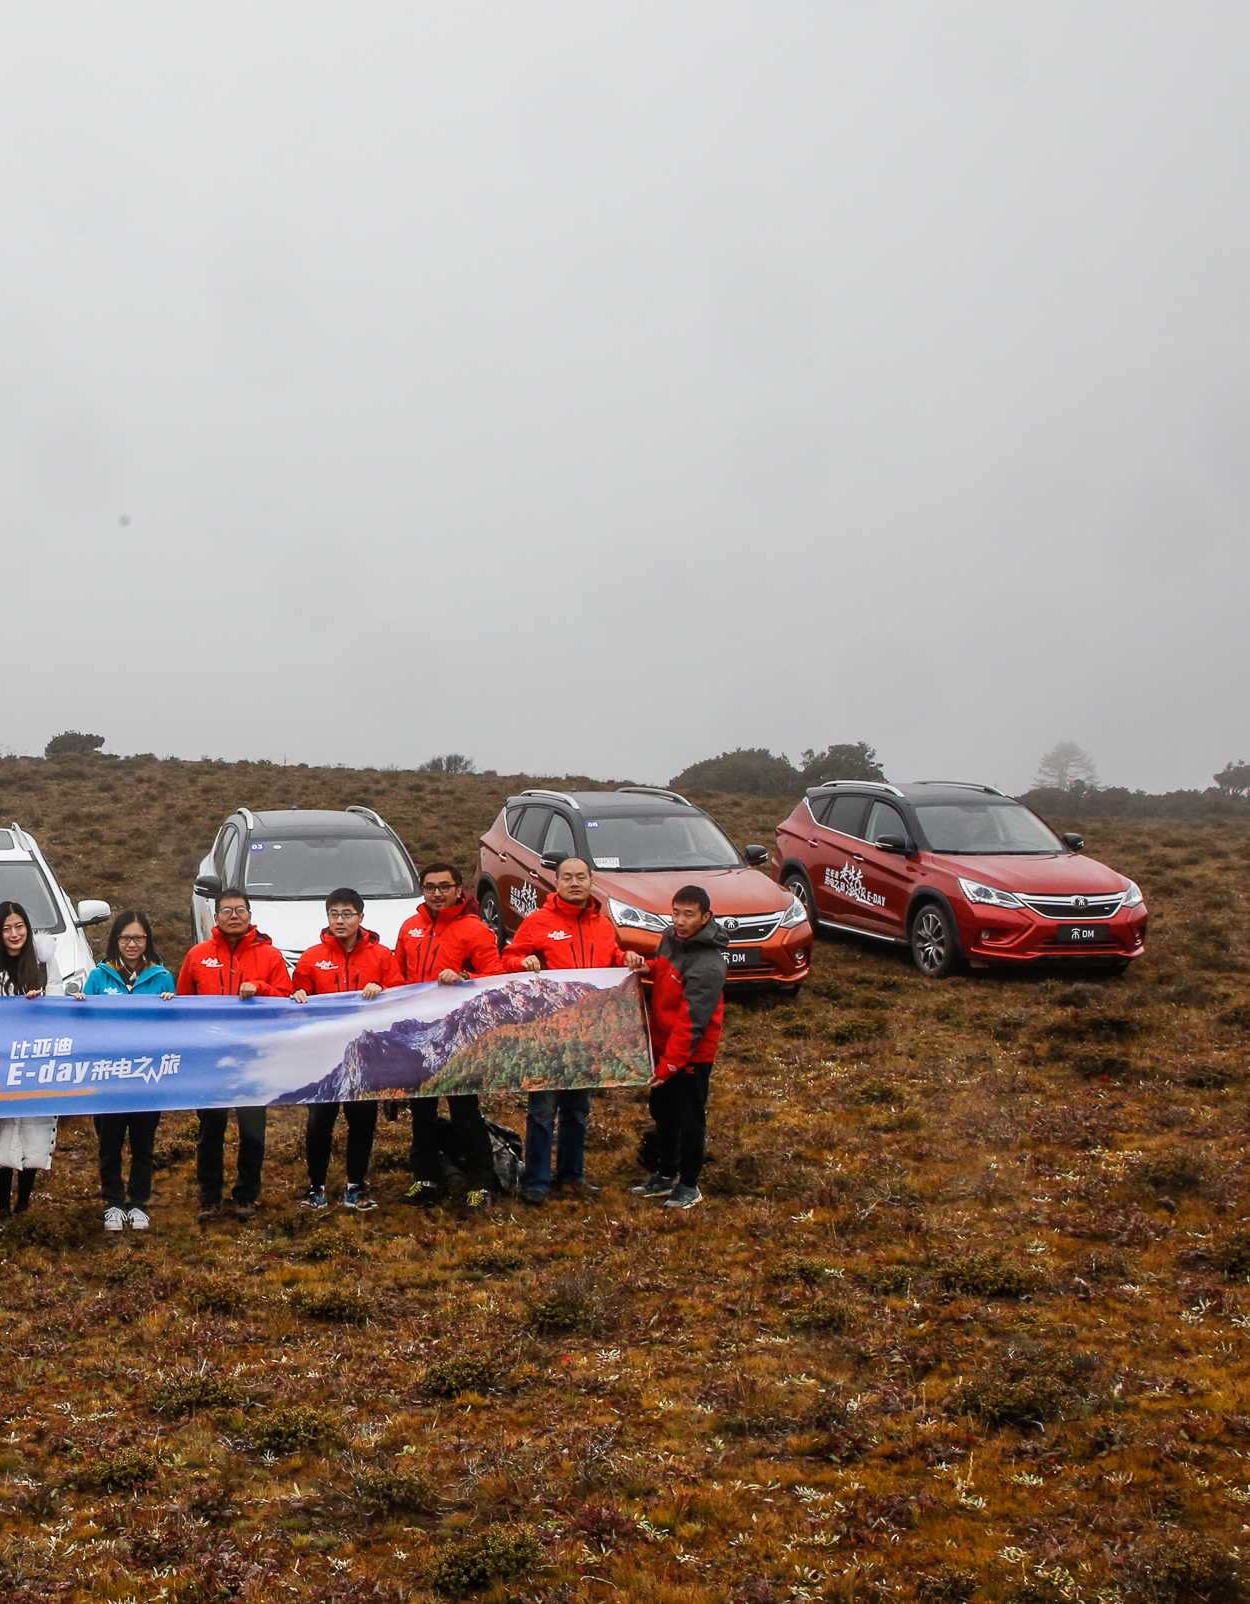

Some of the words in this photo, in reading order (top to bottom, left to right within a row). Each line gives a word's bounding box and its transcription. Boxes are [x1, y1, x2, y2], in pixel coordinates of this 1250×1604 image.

[866, 891, 886, 907] E-DAY
[1082, 930, 1094, 938] DM
[732, 953, 746, 963] DM
[10, 1037, 73, 1060] 比亚迪
[6, 1059, 91, 1086] E-day
[90, 1054, 182, 1084] 来电之旅
